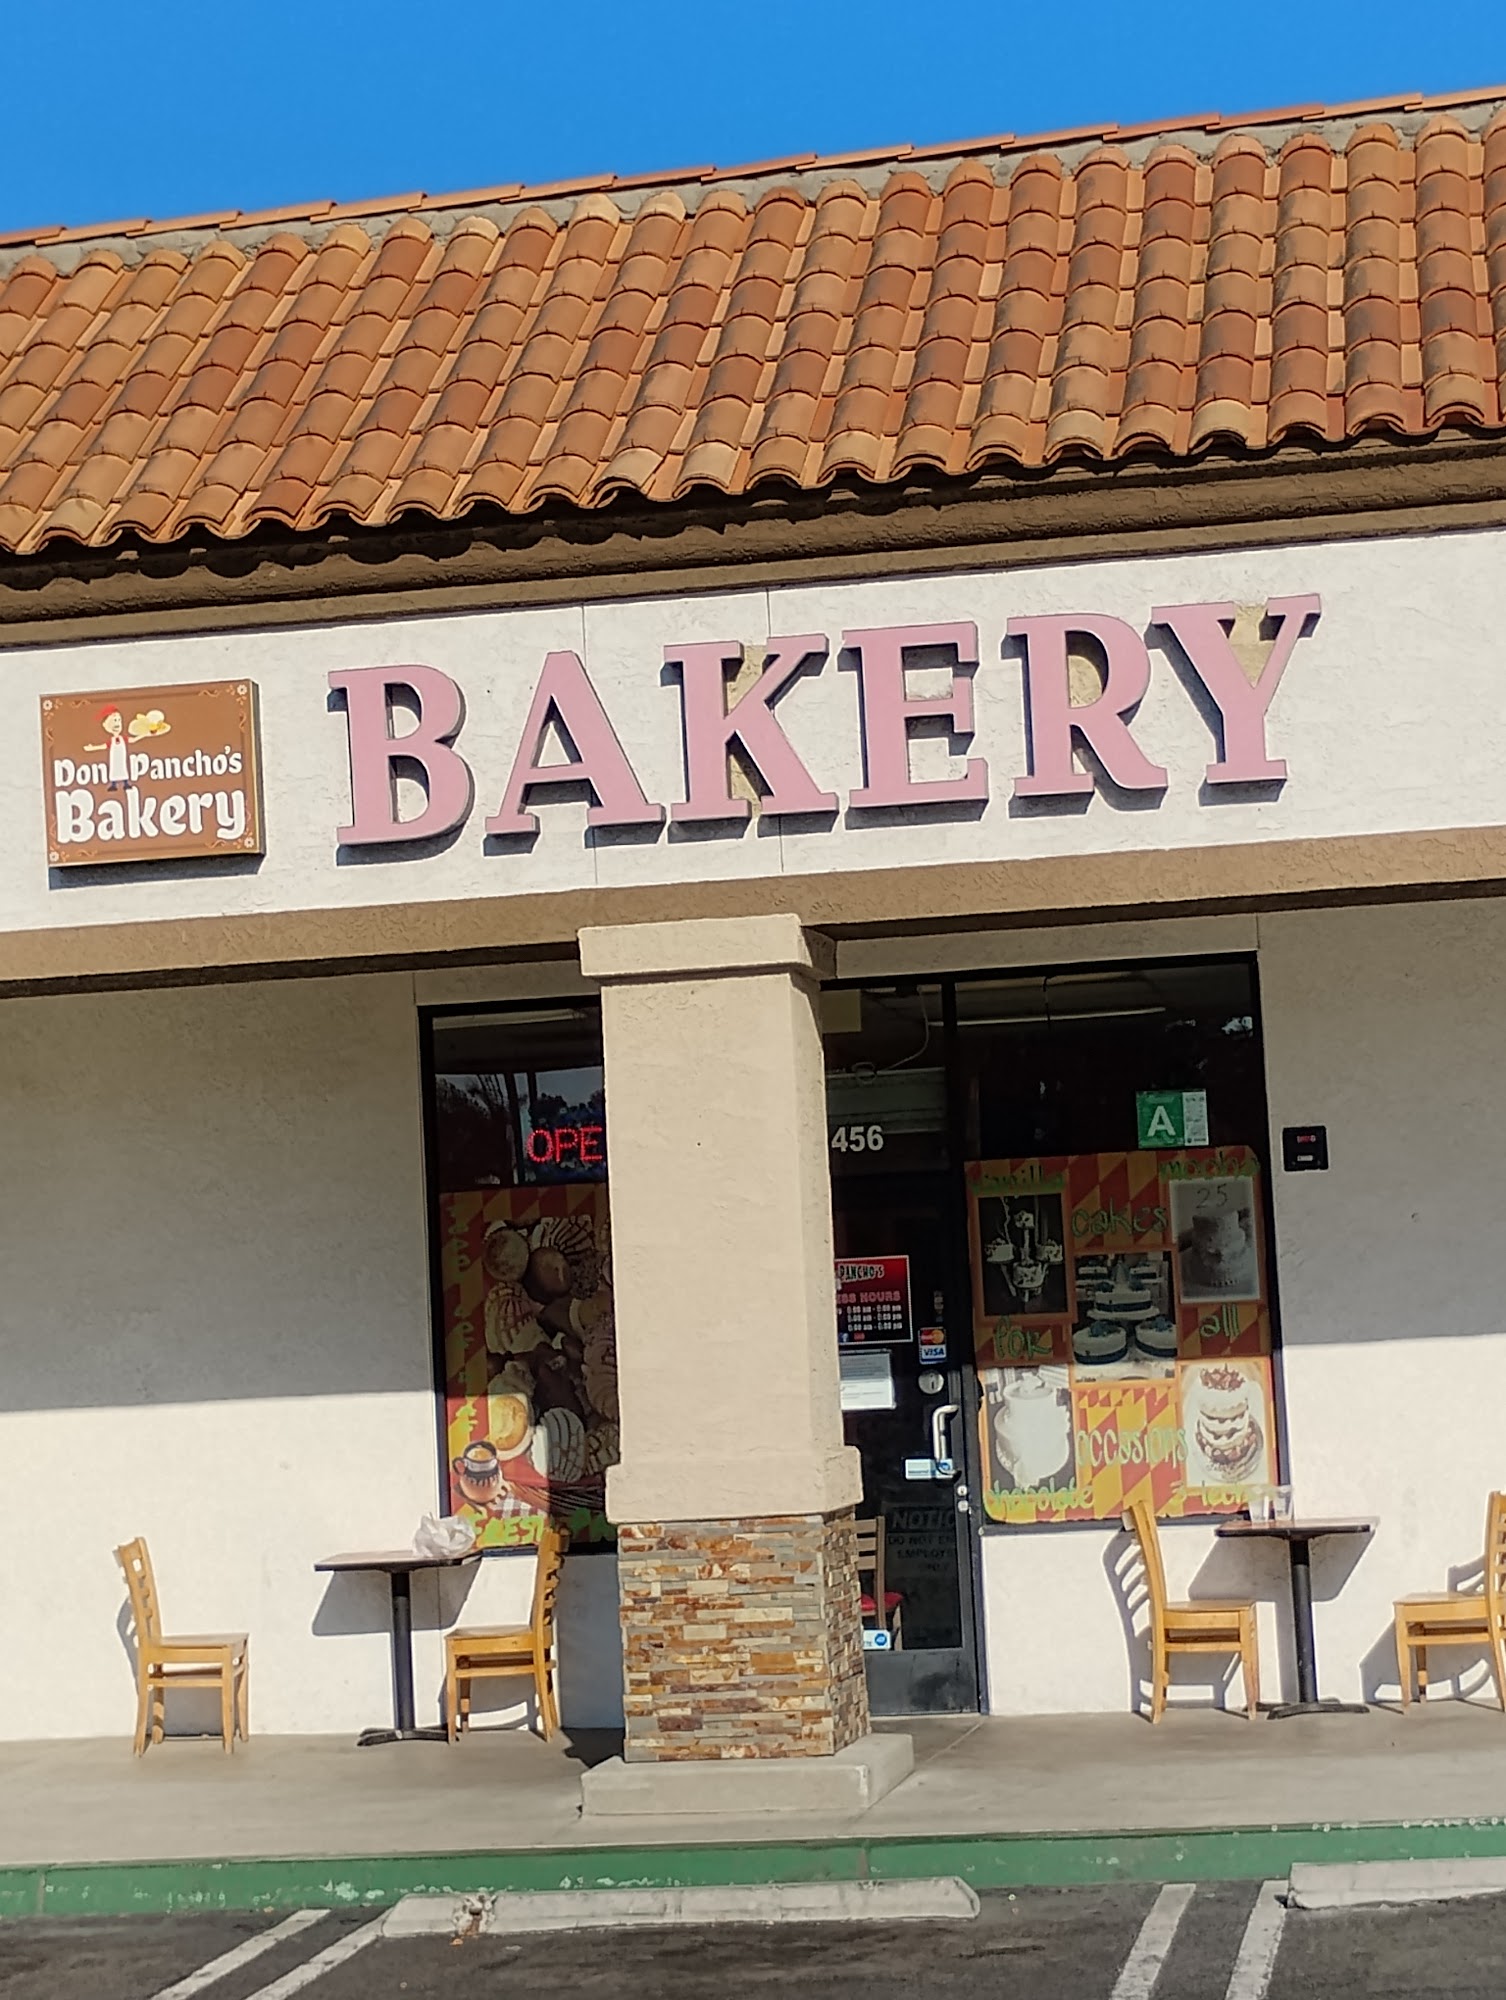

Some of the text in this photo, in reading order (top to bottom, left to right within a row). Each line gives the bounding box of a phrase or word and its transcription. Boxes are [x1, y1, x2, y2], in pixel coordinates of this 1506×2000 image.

[328, 594, 1321, 843] BAKERY
[54, 746, 242, 787] Don Pancho's
[55, 786, 246, 844] Bakery
[831, 1125, 884, 1152] 456
[1147, 1105, 1176, 1137] A
[526, 1125, 602, 1164] OPE
[1072, 1197, 1168, 1238] cakes
[838, 1264, 885, 1281] PANCHO'S
[859, 1291, 901, 1303] HOURS
[1200, 1302, 1240, 1338] all
[923, 1348, 945, 1357] VISA
[1077, 1428, 1188, 1469] occasions
[892, 1509, 954, 1530] NOTIC
